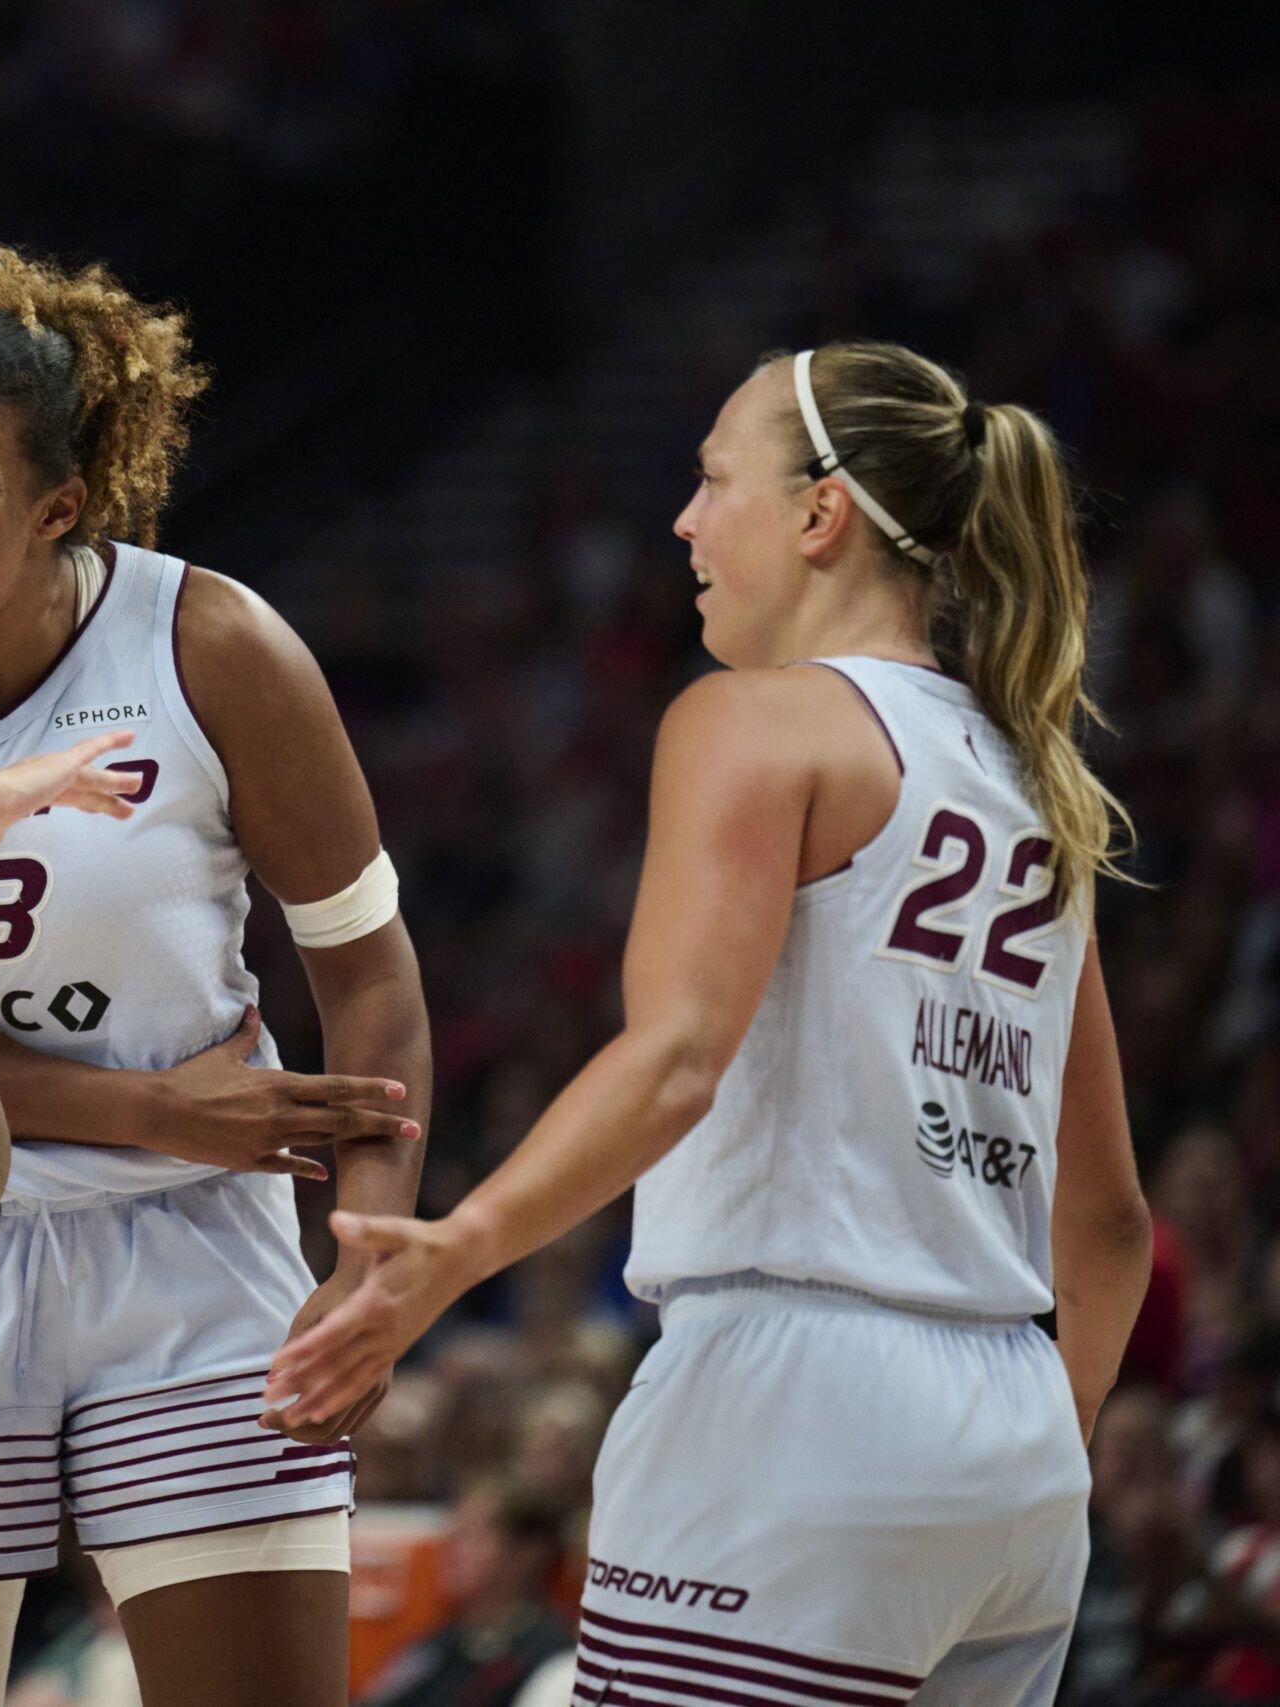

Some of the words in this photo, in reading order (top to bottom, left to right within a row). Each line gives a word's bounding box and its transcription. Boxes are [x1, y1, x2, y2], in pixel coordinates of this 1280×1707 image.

[54, 703, 148, 729] SEPHORA
[876, 803, 1072, 998] 22
[911, 997, 1032, 1098] ALLEMAND
[956, 1127, 1037, 1190] AT&T
